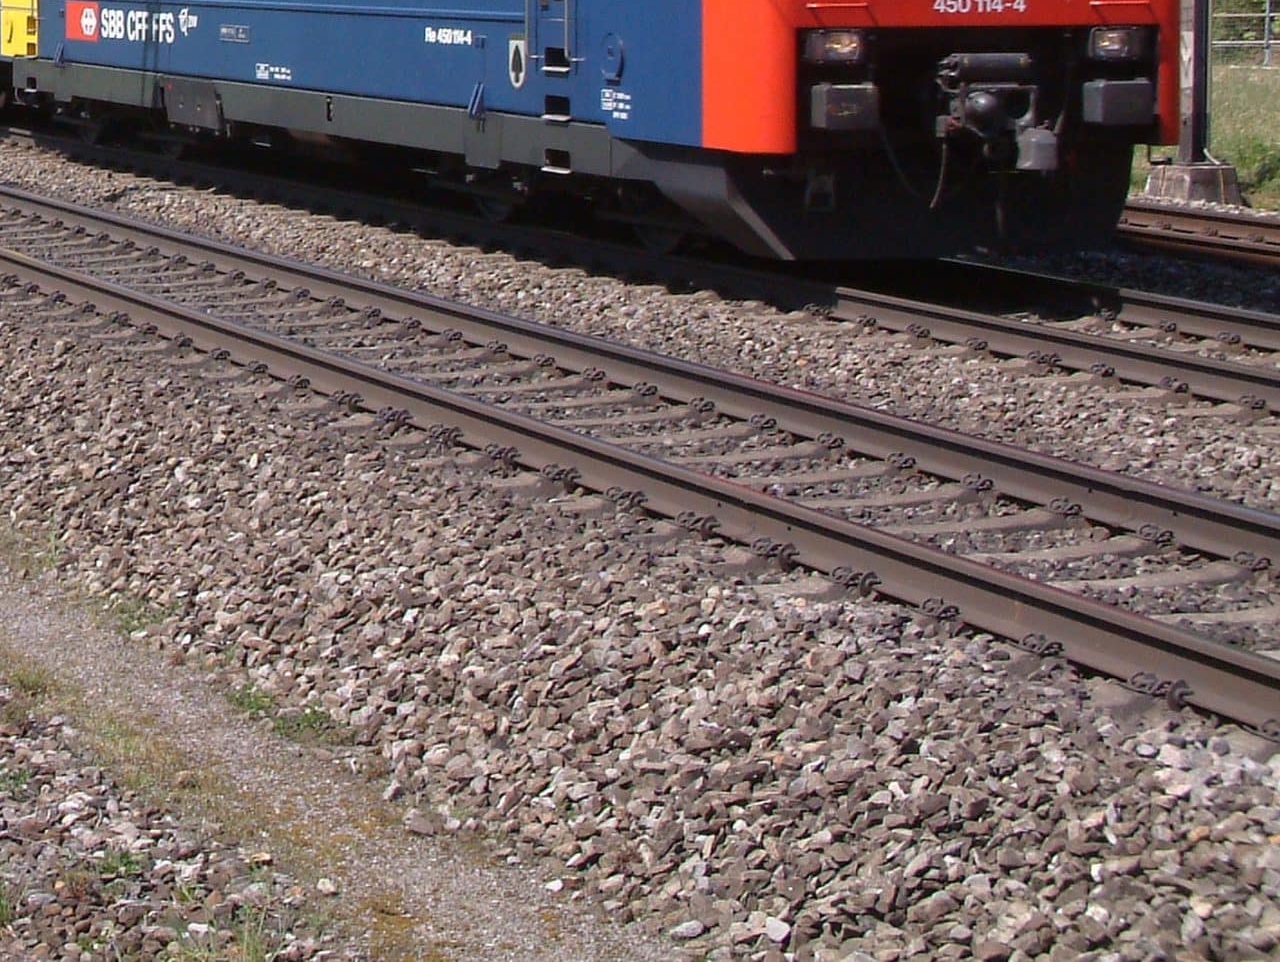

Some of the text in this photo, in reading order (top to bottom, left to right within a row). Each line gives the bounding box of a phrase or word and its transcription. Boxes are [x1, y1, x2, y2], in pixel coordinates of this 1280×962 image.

[100, 8, 174, 44] SBB CFF FFS
